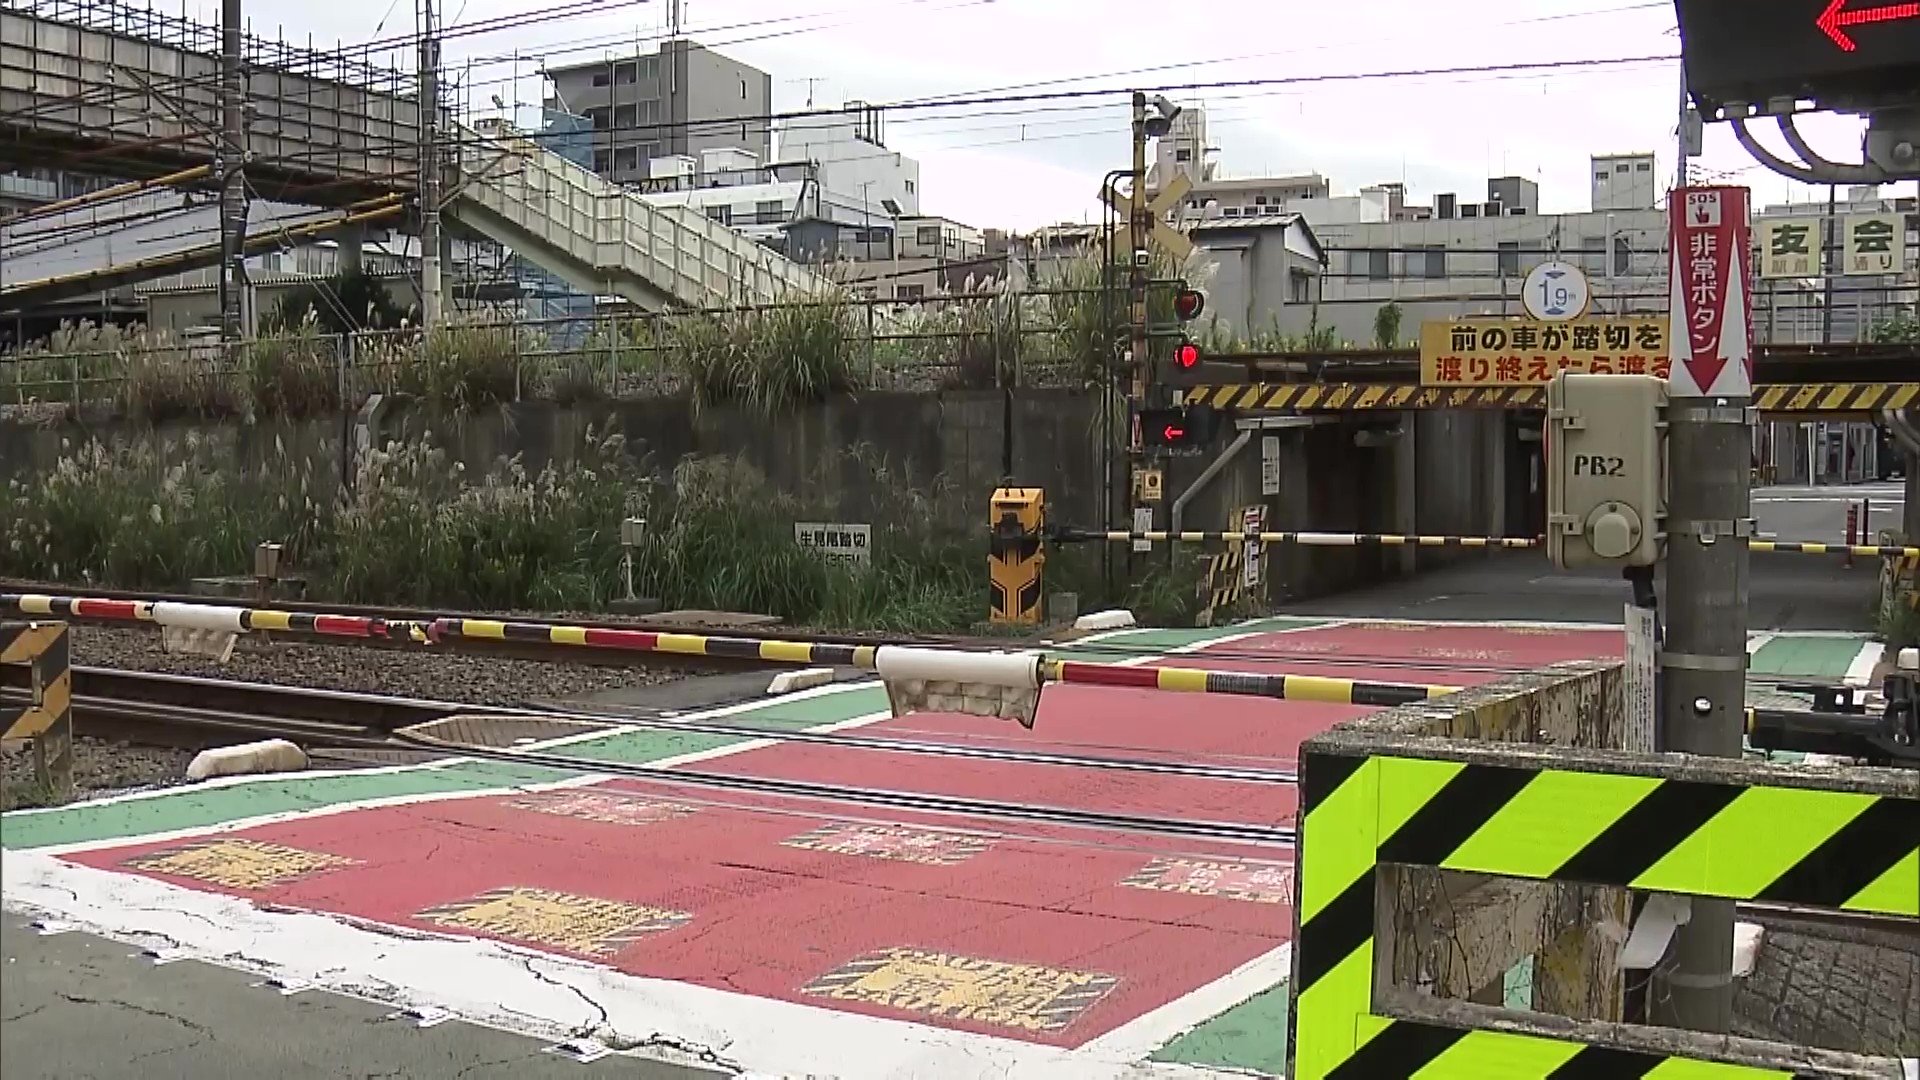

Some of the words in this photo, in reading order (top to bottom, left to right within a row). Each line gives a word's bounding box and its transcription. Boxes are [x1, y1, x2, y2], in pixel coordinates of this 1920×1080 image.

[1688, 193, 1718, 205] SOS
[1854, 220, 1894, 253] 会
[1690, 231, 1718, 354] 非常ボタン
[1450, 324, 1662, 352] 前の車が踏切を
[1573, 455, 1626, 477] PB2
